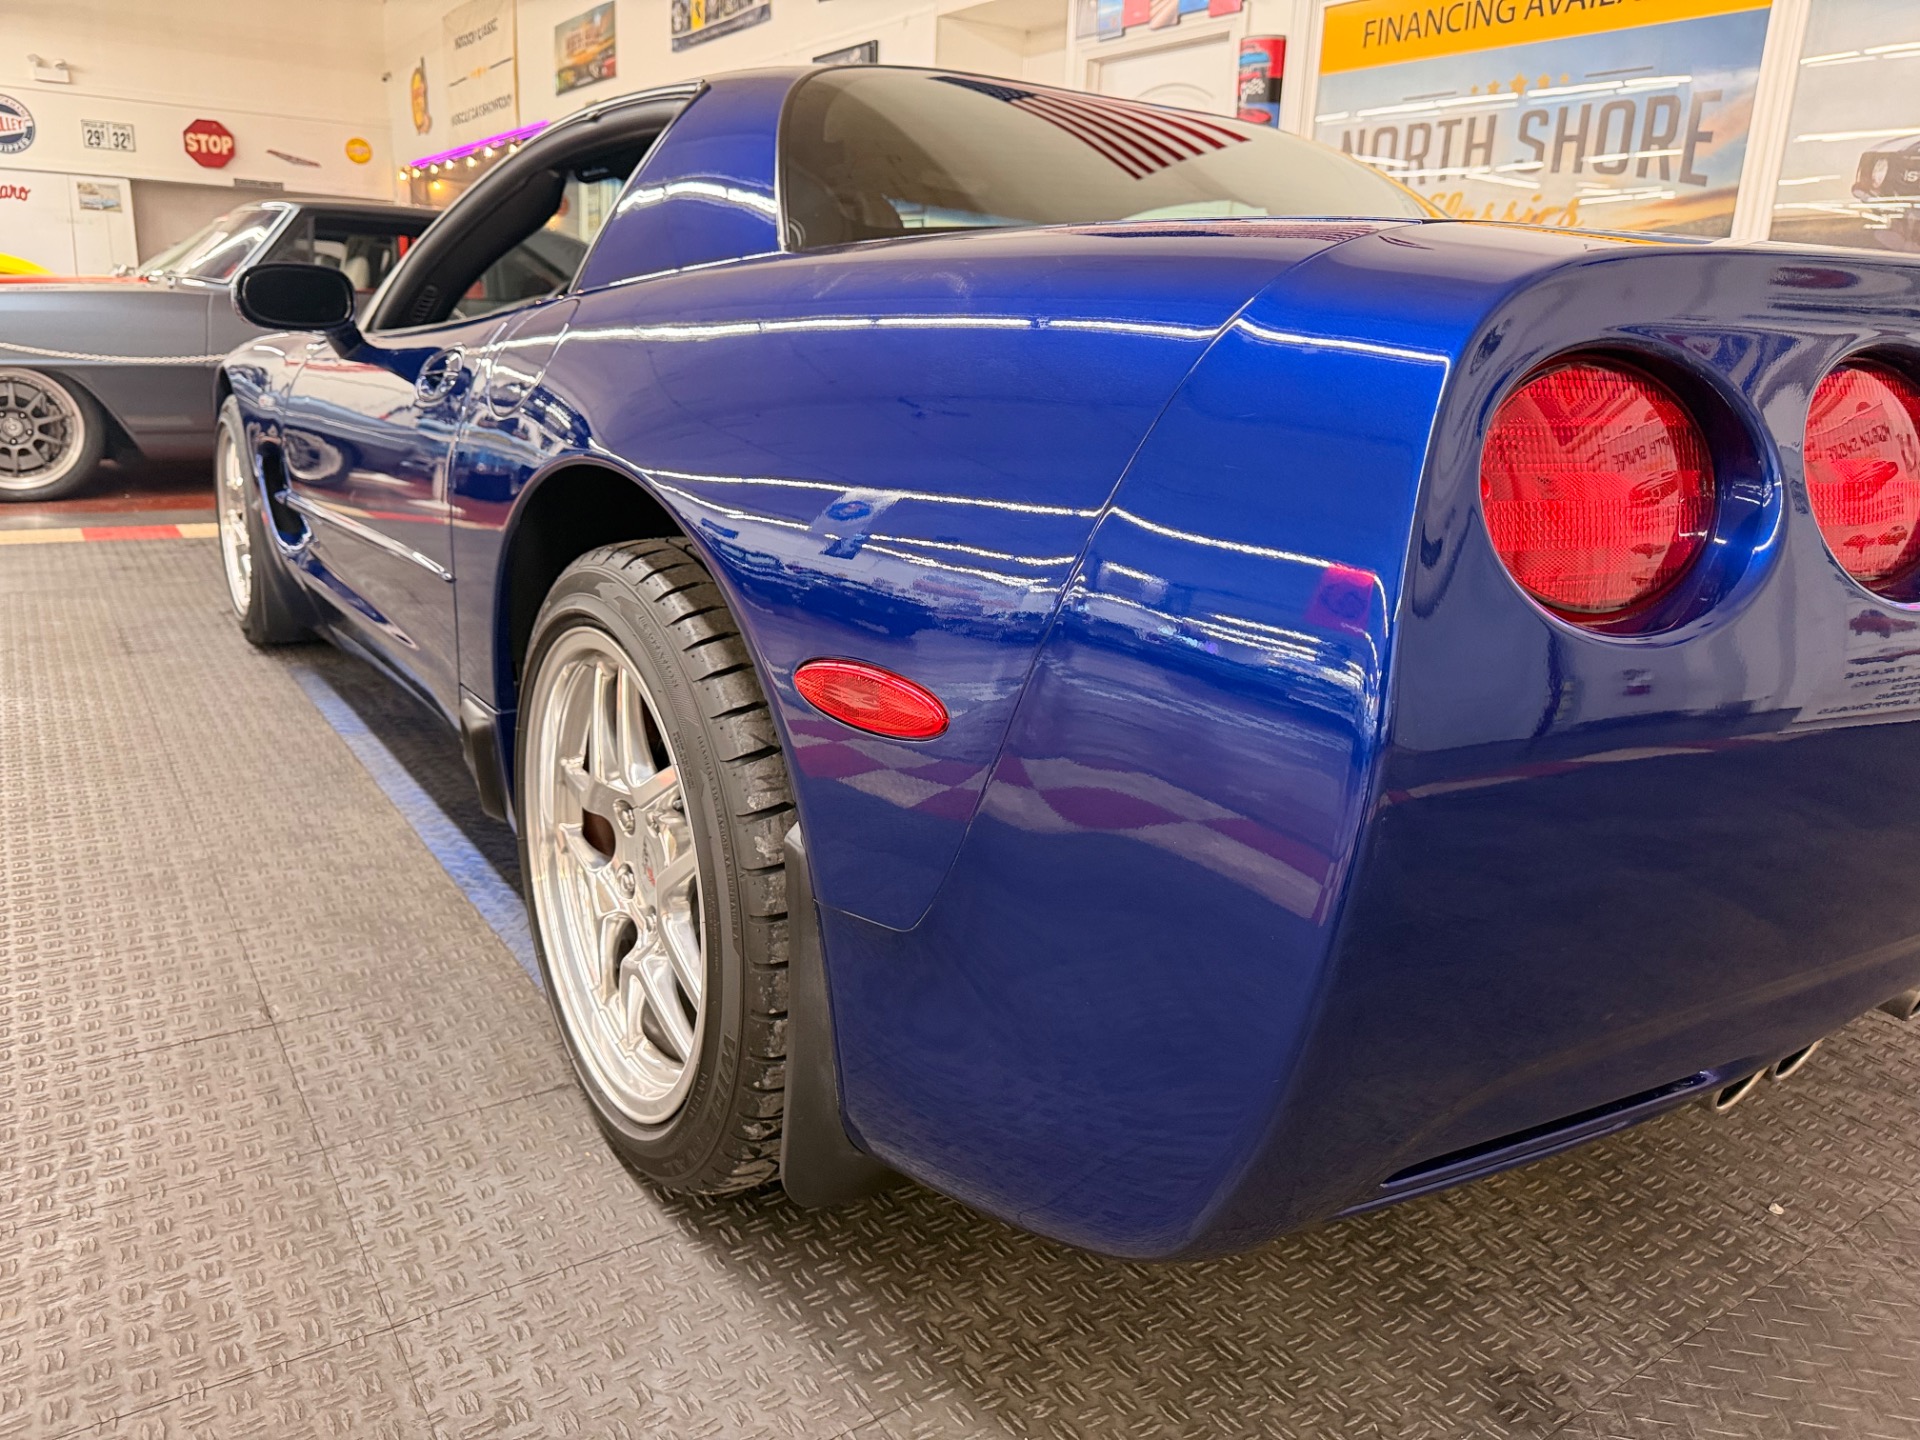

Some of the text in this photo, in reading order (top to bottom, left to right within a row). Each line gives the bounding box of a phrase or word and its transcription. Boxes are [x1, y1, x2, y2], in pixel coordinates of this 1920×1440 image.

[1363, 0, 1516, 48] FINANCING
[185, 133, 234, 155] STOP
[1515, 88, 1724, 188] SHORE
